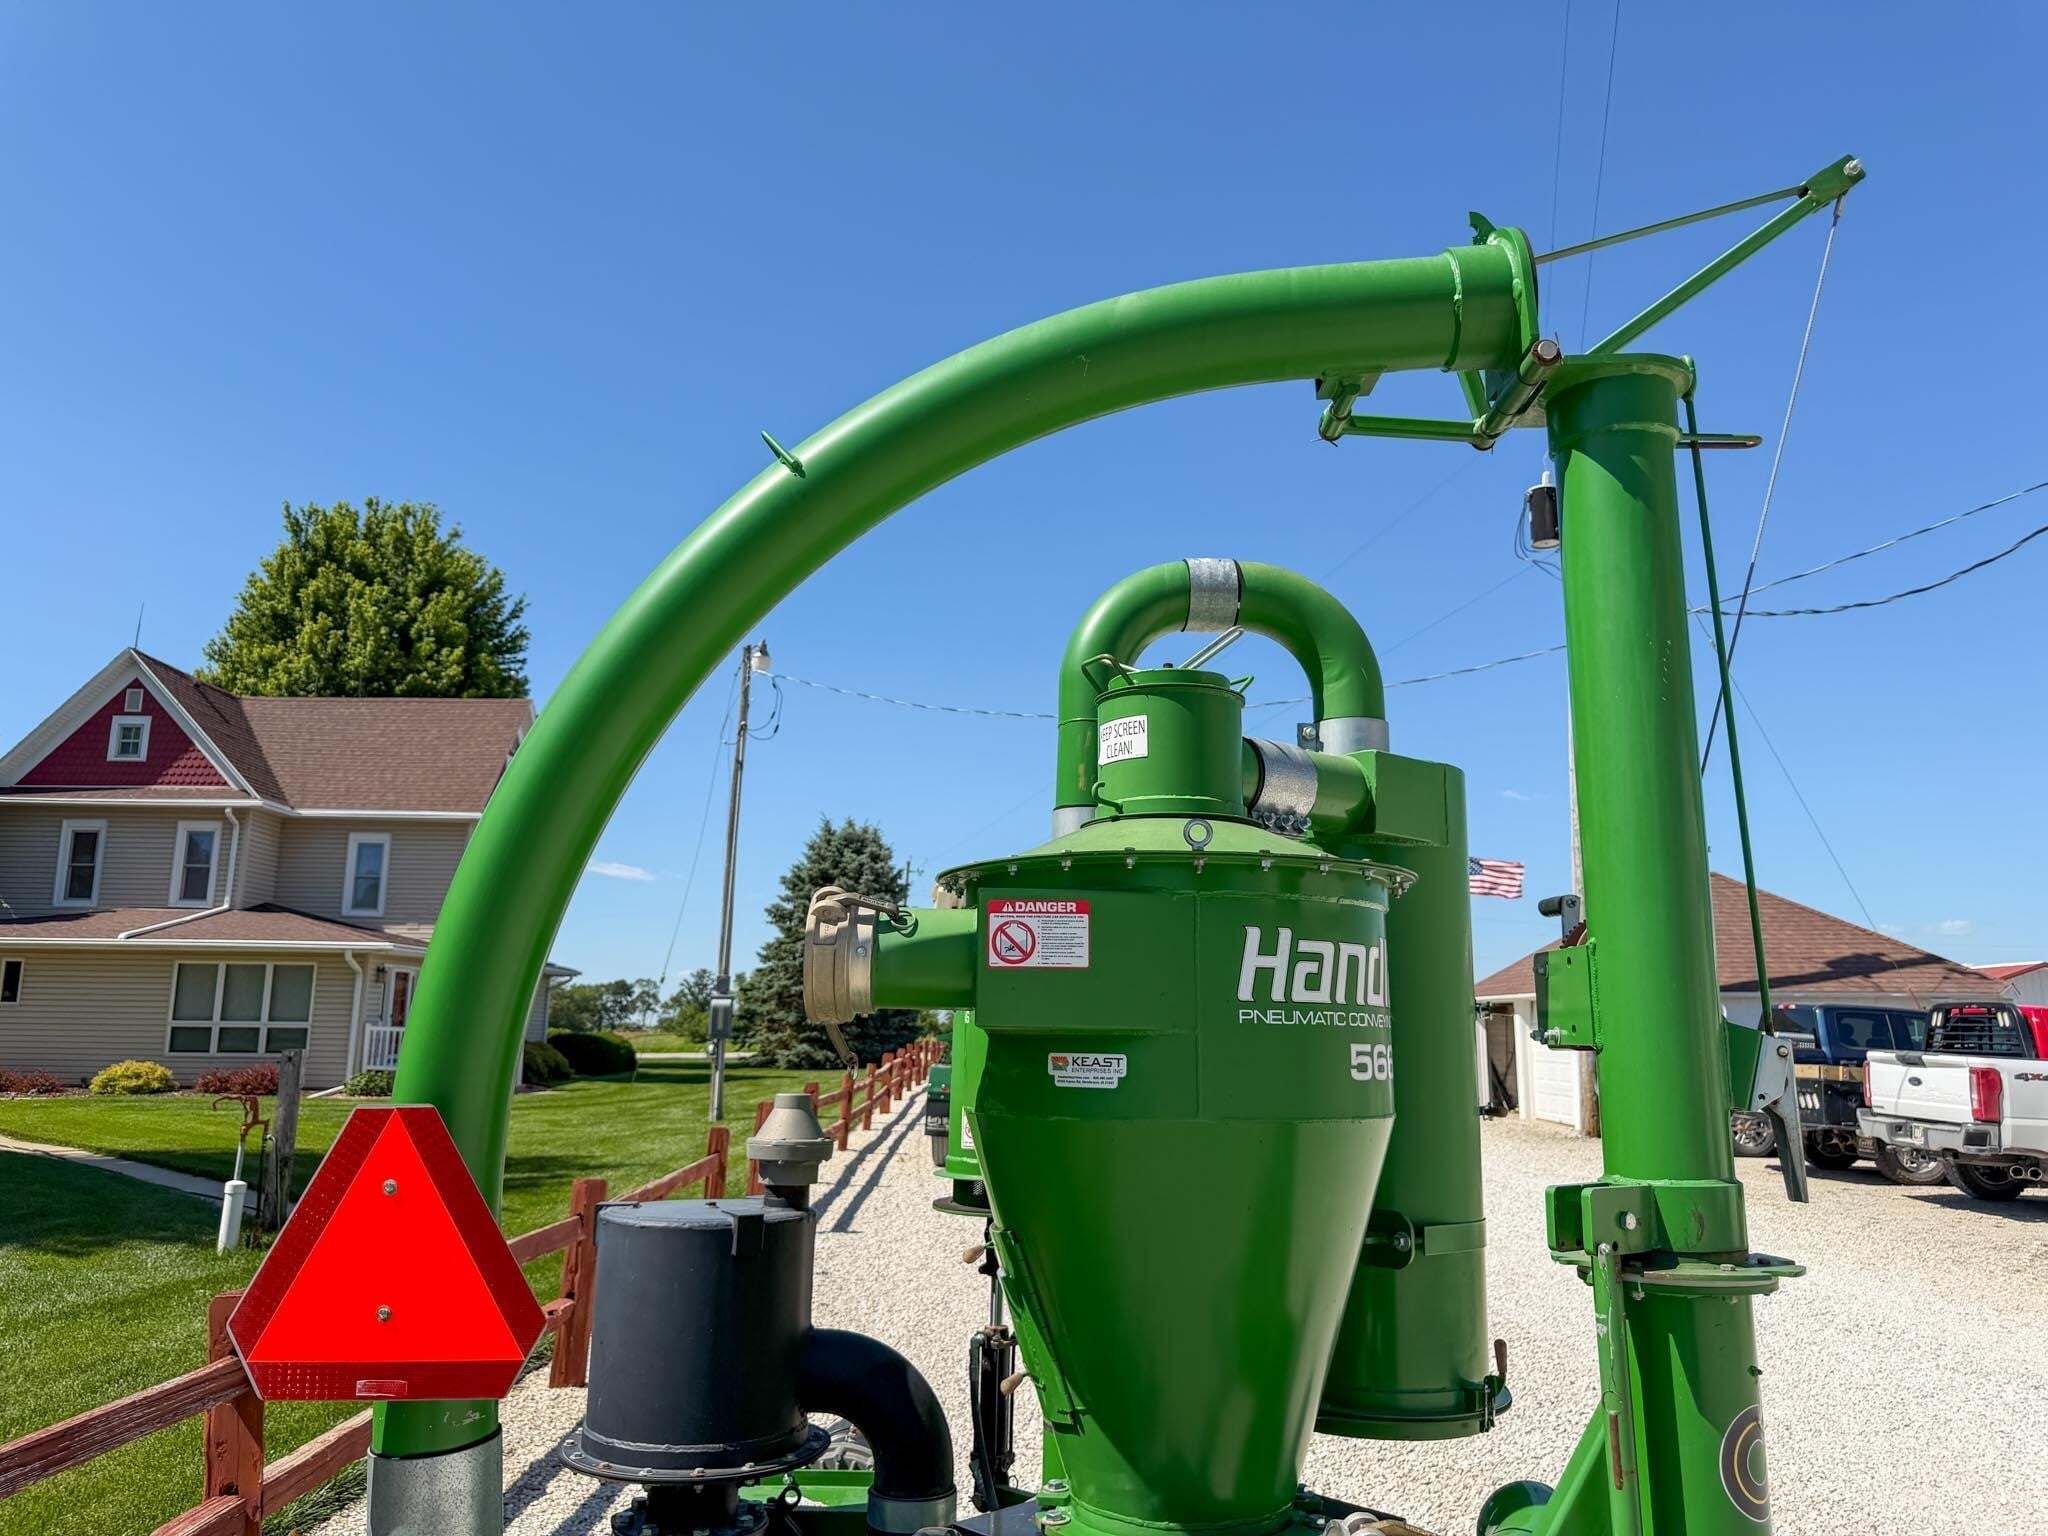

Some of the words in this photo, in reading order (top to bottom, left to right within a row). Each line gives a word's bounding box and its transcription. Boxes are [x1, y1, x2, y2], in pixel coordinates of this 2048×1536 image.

[1114, 720, 1145, 739] SCREEN
[1107, 740, 1133, 759] CLEAN!
[1015, 901, 1076, 912] DANGER
[1239, 1009, 1347, 1026] PNEUMATIC
[1072, 1056, 1123, 1068] KEAST
